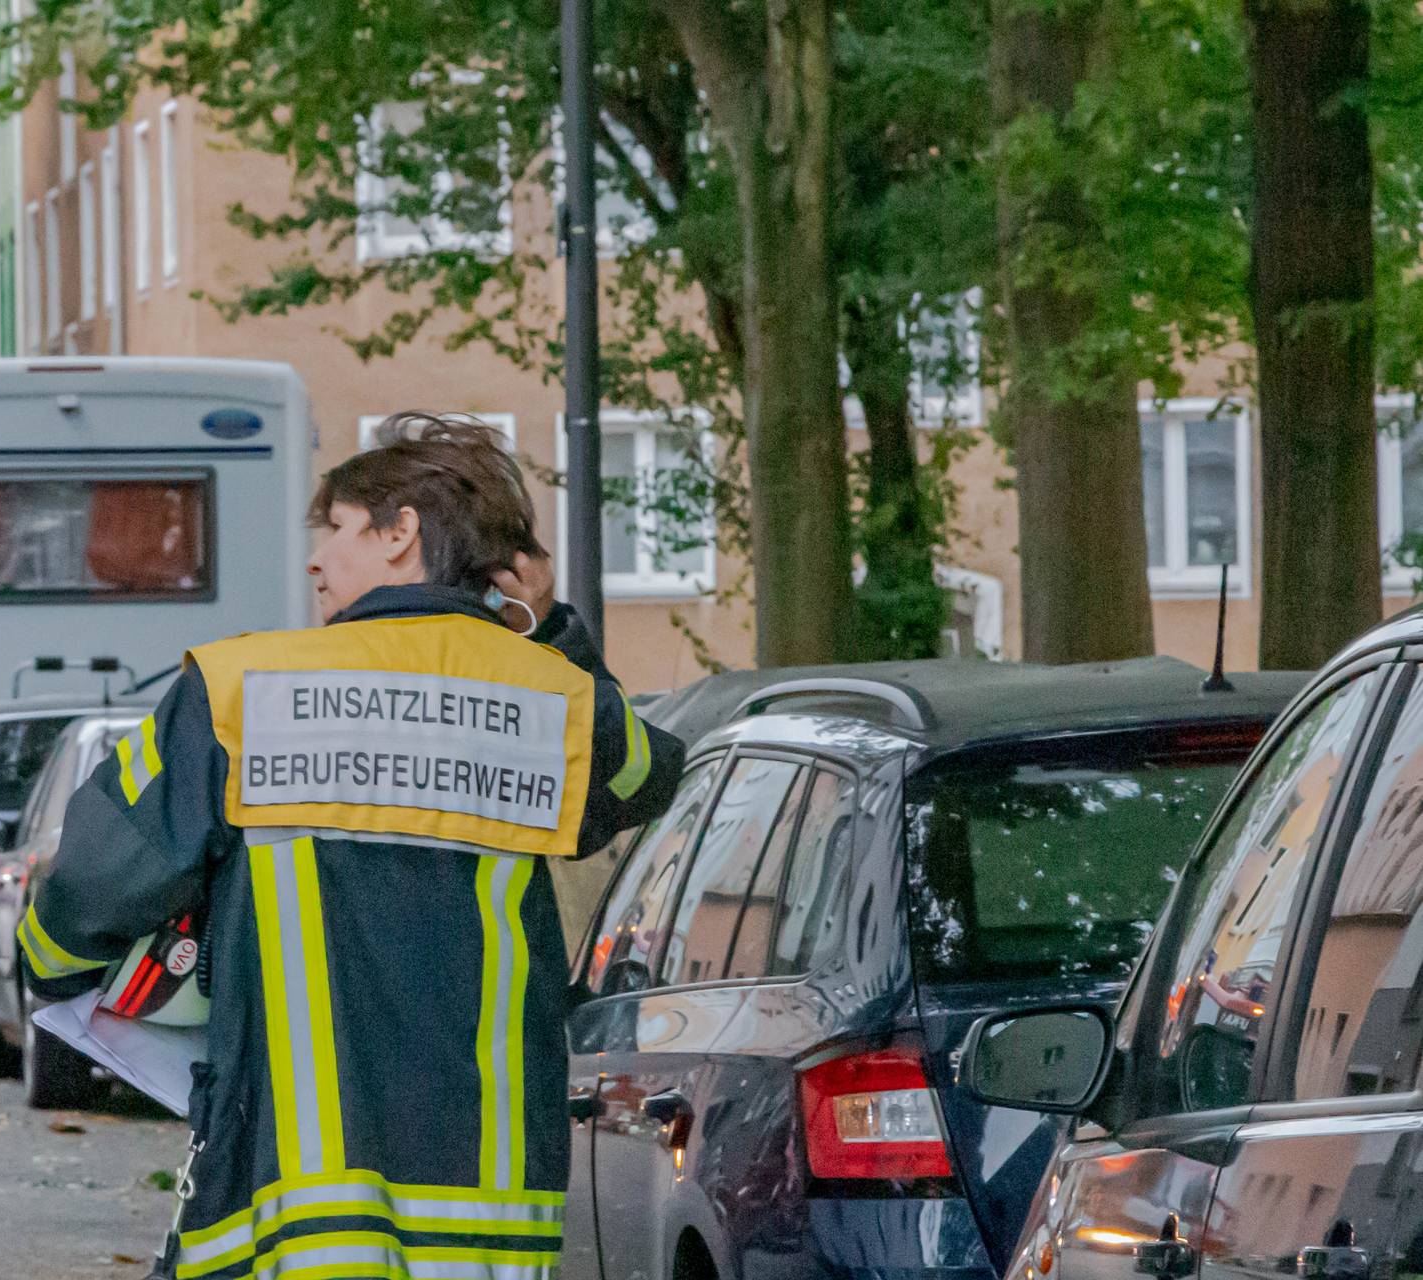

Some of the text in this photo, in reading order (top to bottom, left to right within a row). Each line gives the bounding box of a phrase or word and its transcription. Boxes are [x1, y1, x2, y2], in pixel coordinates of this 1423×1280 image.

[292, 686, 523, 737] EINSATZLEITER
[248, 751, 557, 811] BERUFSFEUERWEHR
[170, 942, 196, 971] OVA
